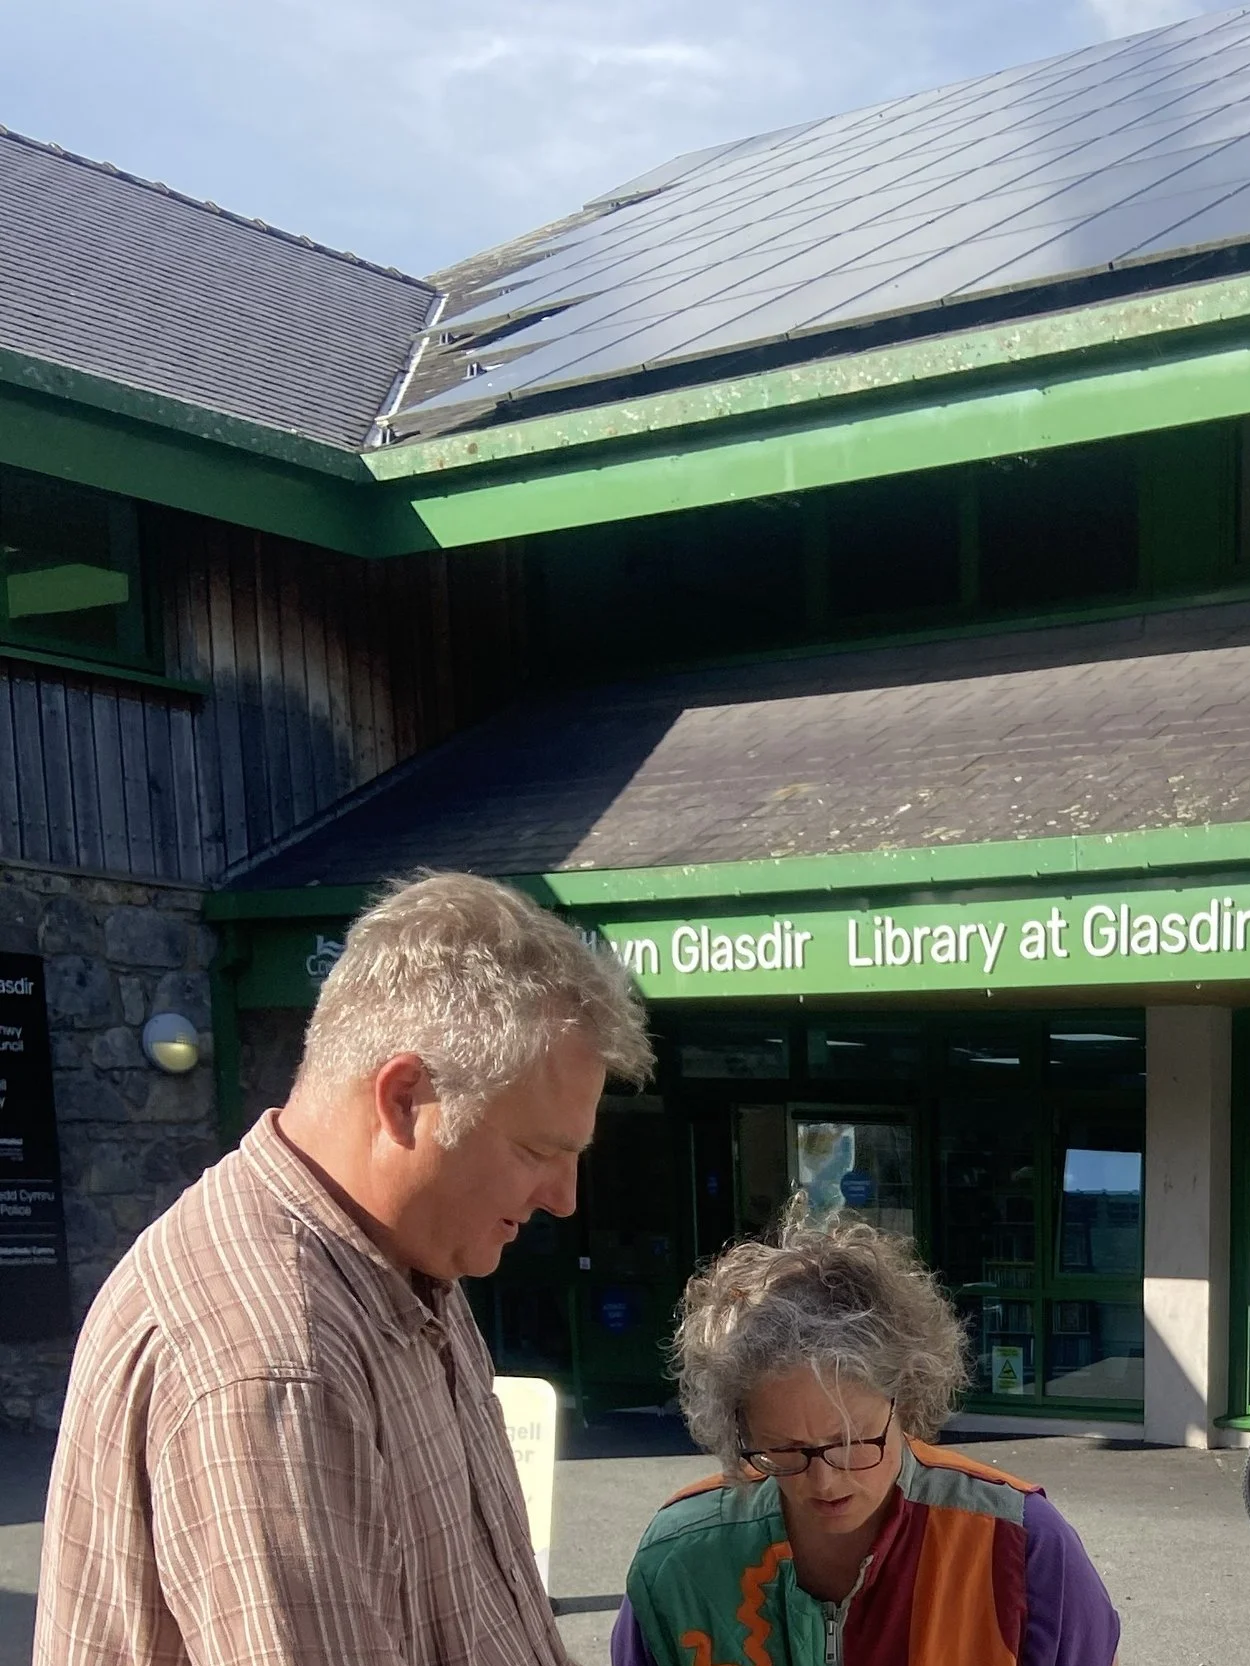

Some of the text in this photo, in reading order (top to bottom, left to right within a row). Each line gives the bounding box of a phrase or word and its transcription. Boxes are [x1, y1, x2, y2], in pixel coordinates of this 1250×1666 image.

[671, 921, 813, 973] Glasdir
[848, 916, 1006, 974] Library
[1019, 906, 1069, 960] at
